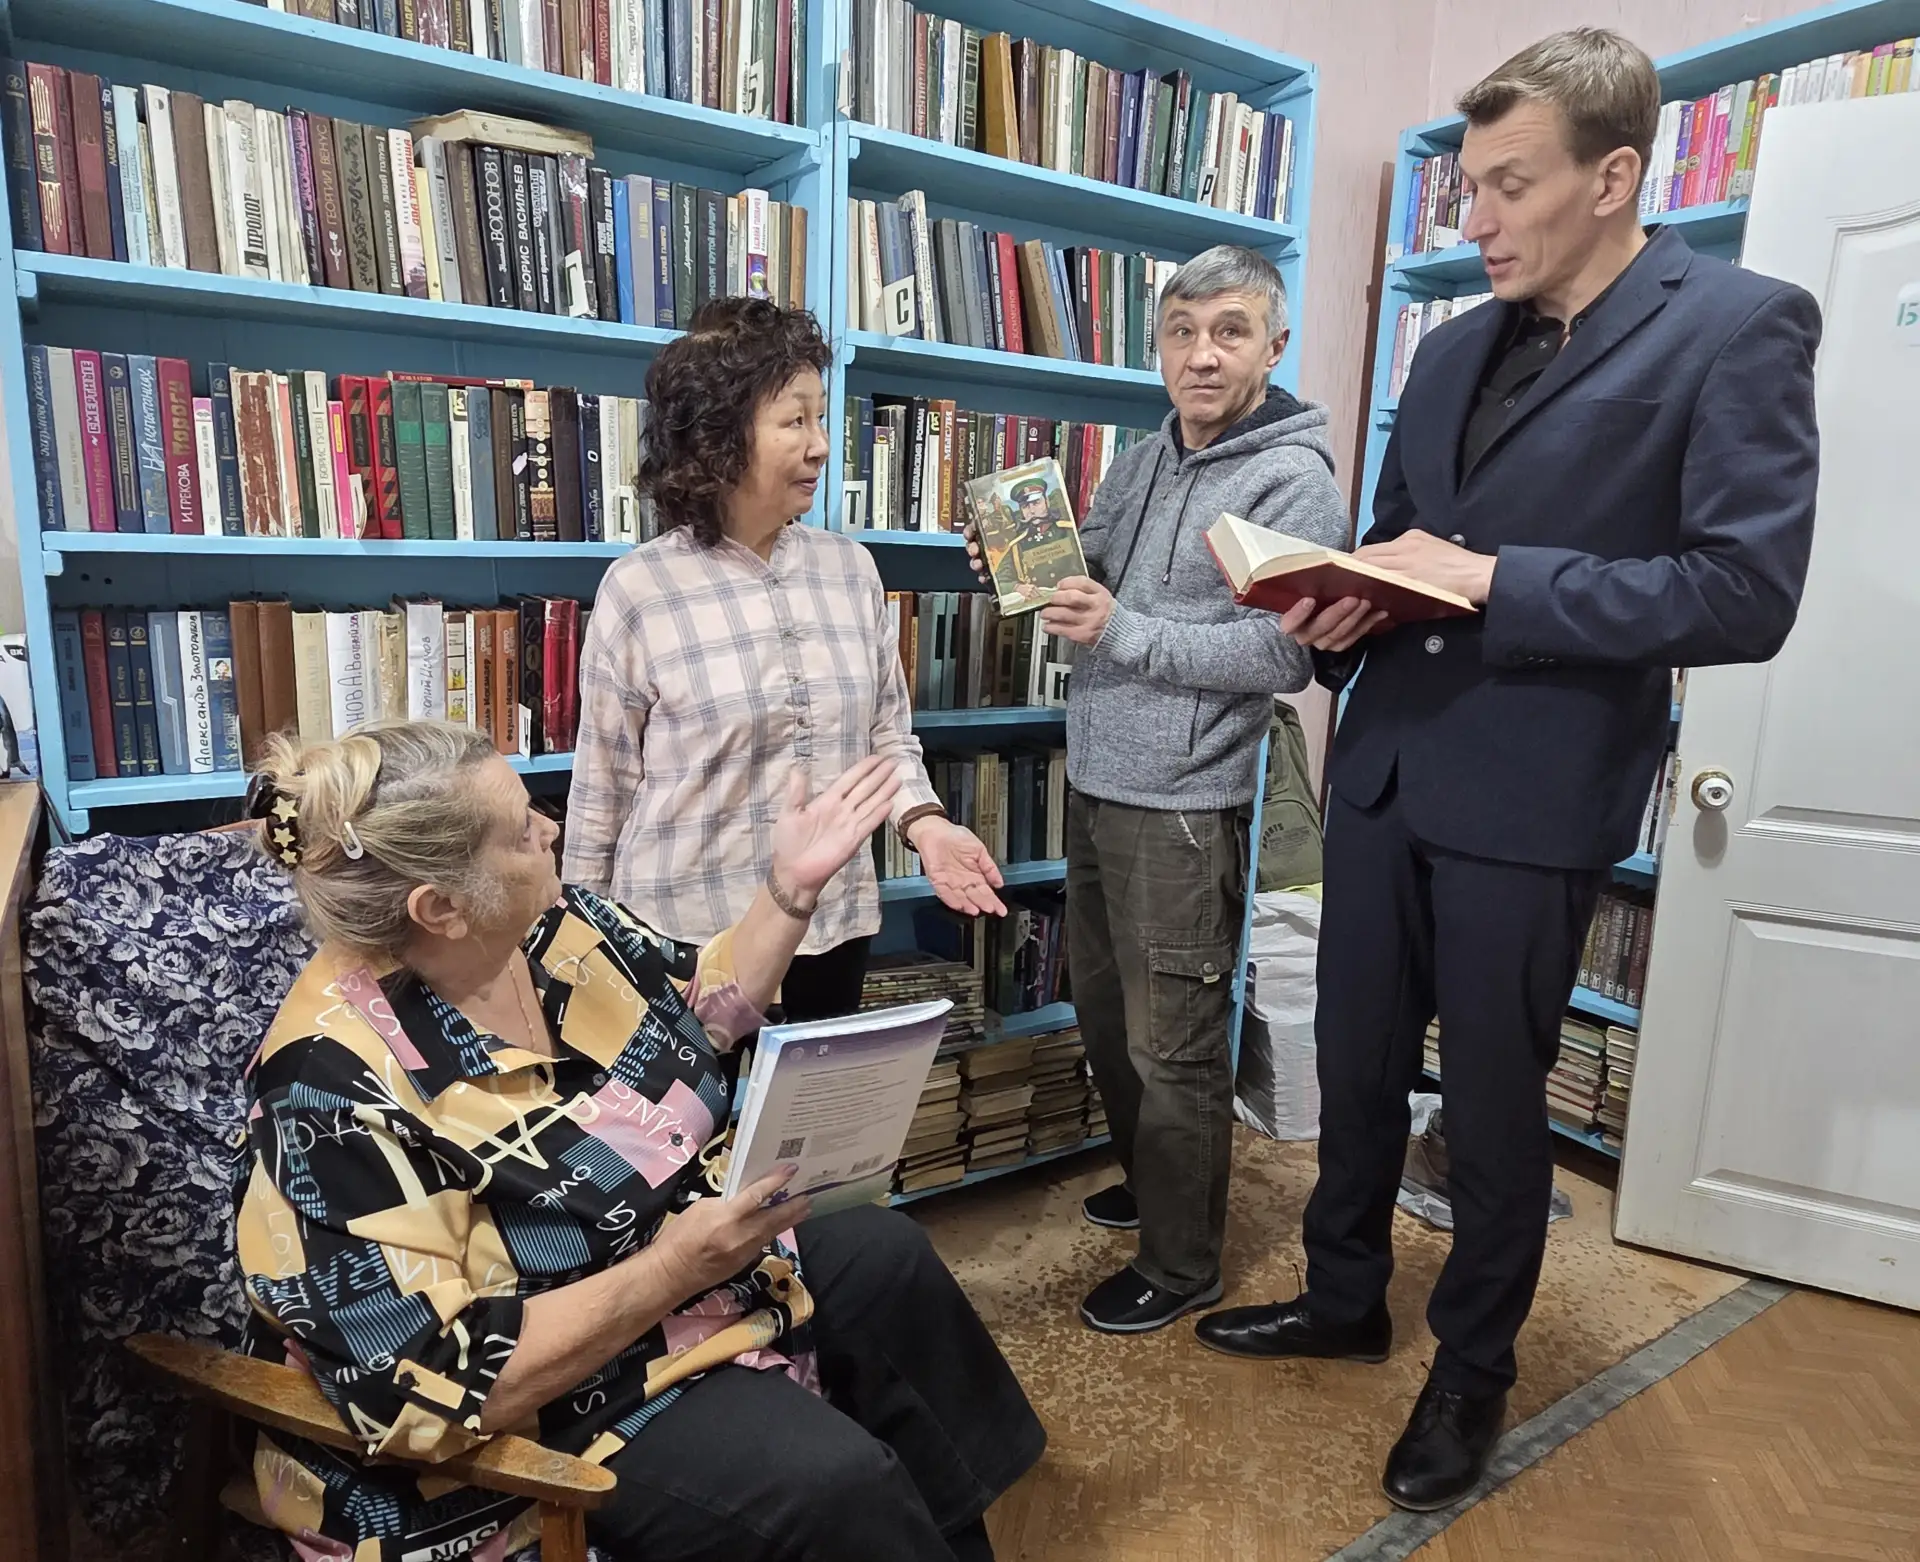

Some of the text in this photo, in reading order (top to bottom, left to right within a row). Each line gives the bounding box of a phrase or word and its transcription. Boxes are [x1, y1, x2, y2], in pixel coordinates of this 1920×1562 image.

[317, 124, 331, 165] ВЕНУС
[403, 138, 421, 227] ДВА ТОВАРИЩА
[484, 161, 505, 243] ВОРОНОВ
[1199, 174, 1214, 202] Р
[243, 192, 265, 251] ПРОЛОГ
[513, 164, 533, 293] БОРИС ВАСИЛЬЕВ
[708, 201, 717, 236] МАРШРУТ
[896, 287, 910, 326] С
[80, 360, 101, 434] СМЕРТНЫЕ
[603, 404, 616, 452] ФОРТУНЫ
[915, 408, 925, 441] РОМАН
[942, 410, 953, 461] МЫСЛИ
[315, 416, 329, 481] БОРИС ГУСЕВ
[605, 453, 617, 490] КОЛЕСО
[845, 490, 861, 525] Т
[194, 683, 212, 767] Александр
[1262, 822, 1285, 850] SPORTS
[1136, 1290, 1154, 1306] MVP
